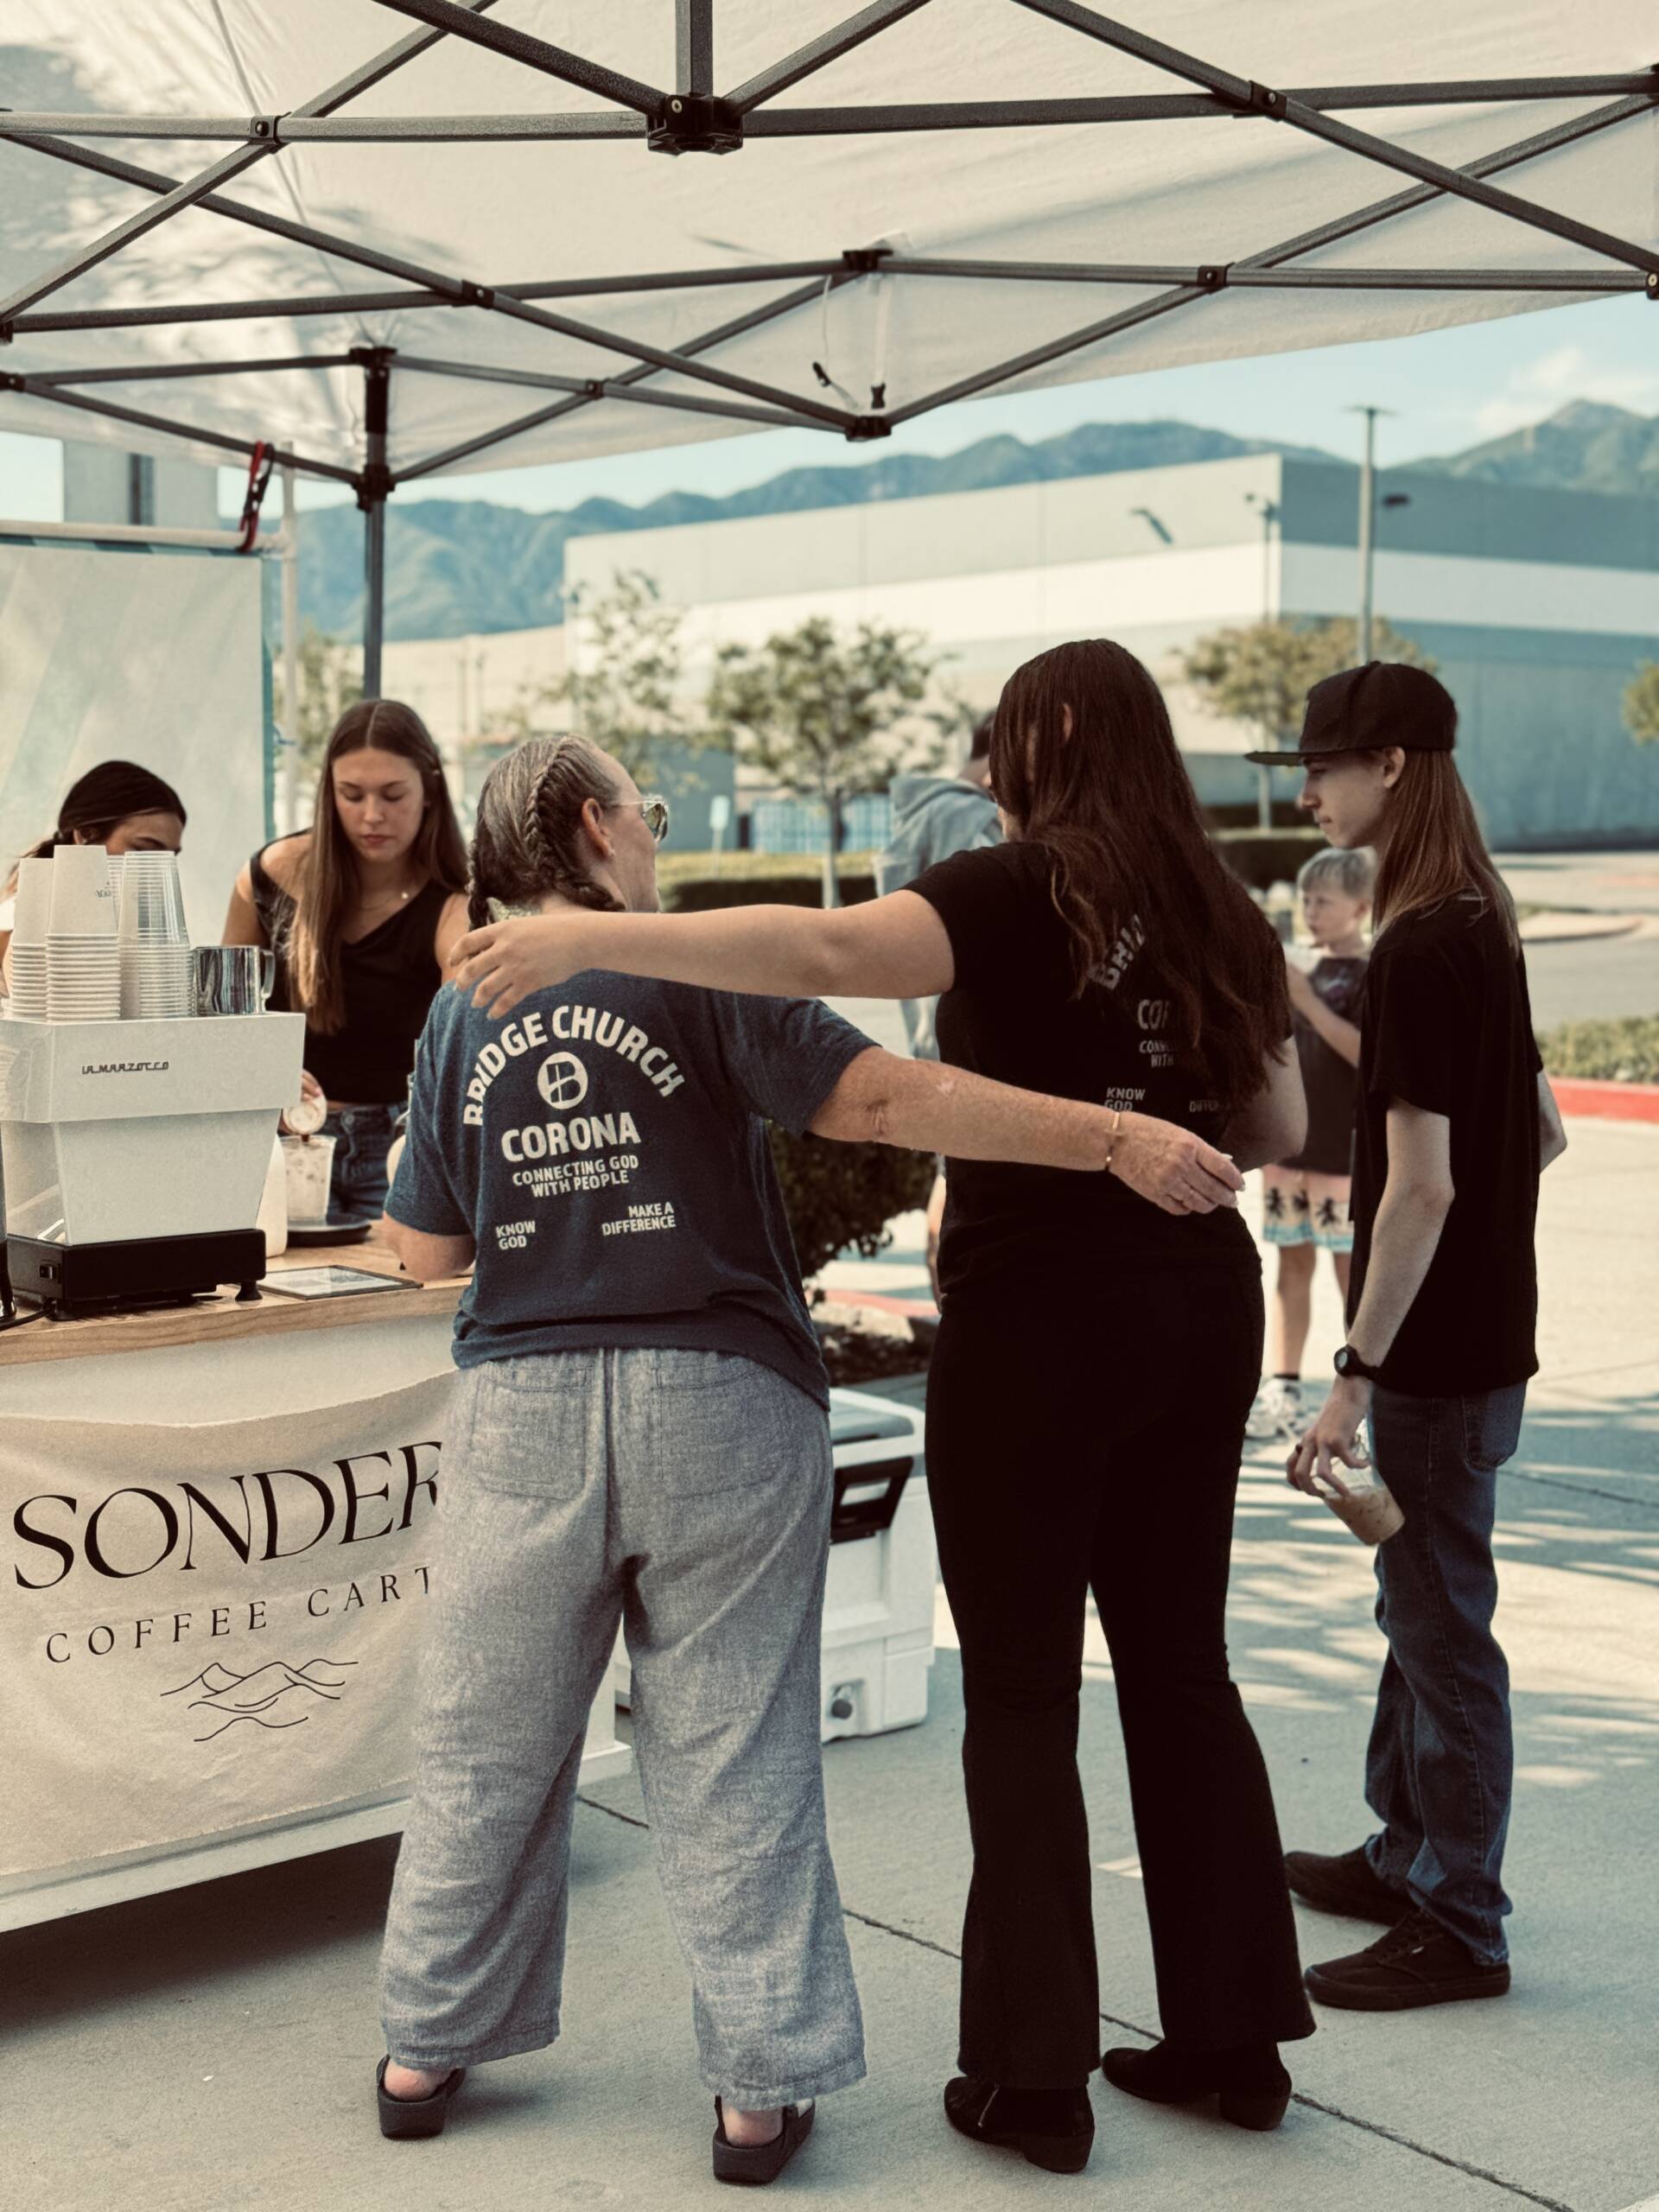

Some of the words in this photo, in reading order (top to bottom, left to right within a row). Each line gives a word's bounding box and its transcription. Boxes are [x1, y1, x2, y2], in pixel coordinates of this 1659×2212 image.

[463, 1012, 549, 1126] BRIDGE
[552, 1005, 685, 1097] CHURCH
[1104, 1100, 1133, 1112] GOD
[1106, 1087, 1146, 1101] KNOW
[501, 1112, 641, 1162] CORONA
[512, 1158, 607, 1186] CONNECTING
[609, 1154, 639, 1169] GOD
[531, 1177, 571, 1198] WITH
[573, 1171, 629, 1192] PEOPLE
[627, 1203, 662, 1218] MAKE
[664, 1201, 675, 1214] A
[495, 1220, 537, 1238] KNOW
[601, 1215, 677, 1236] DIFFERENCE
[499, 1235, 527, 1250] GOD
[13, 1441, 442, 1589] SONDER
[46, 1600, 268, 1663] COFFEE
[308, 1567, 430, 1618] CART
